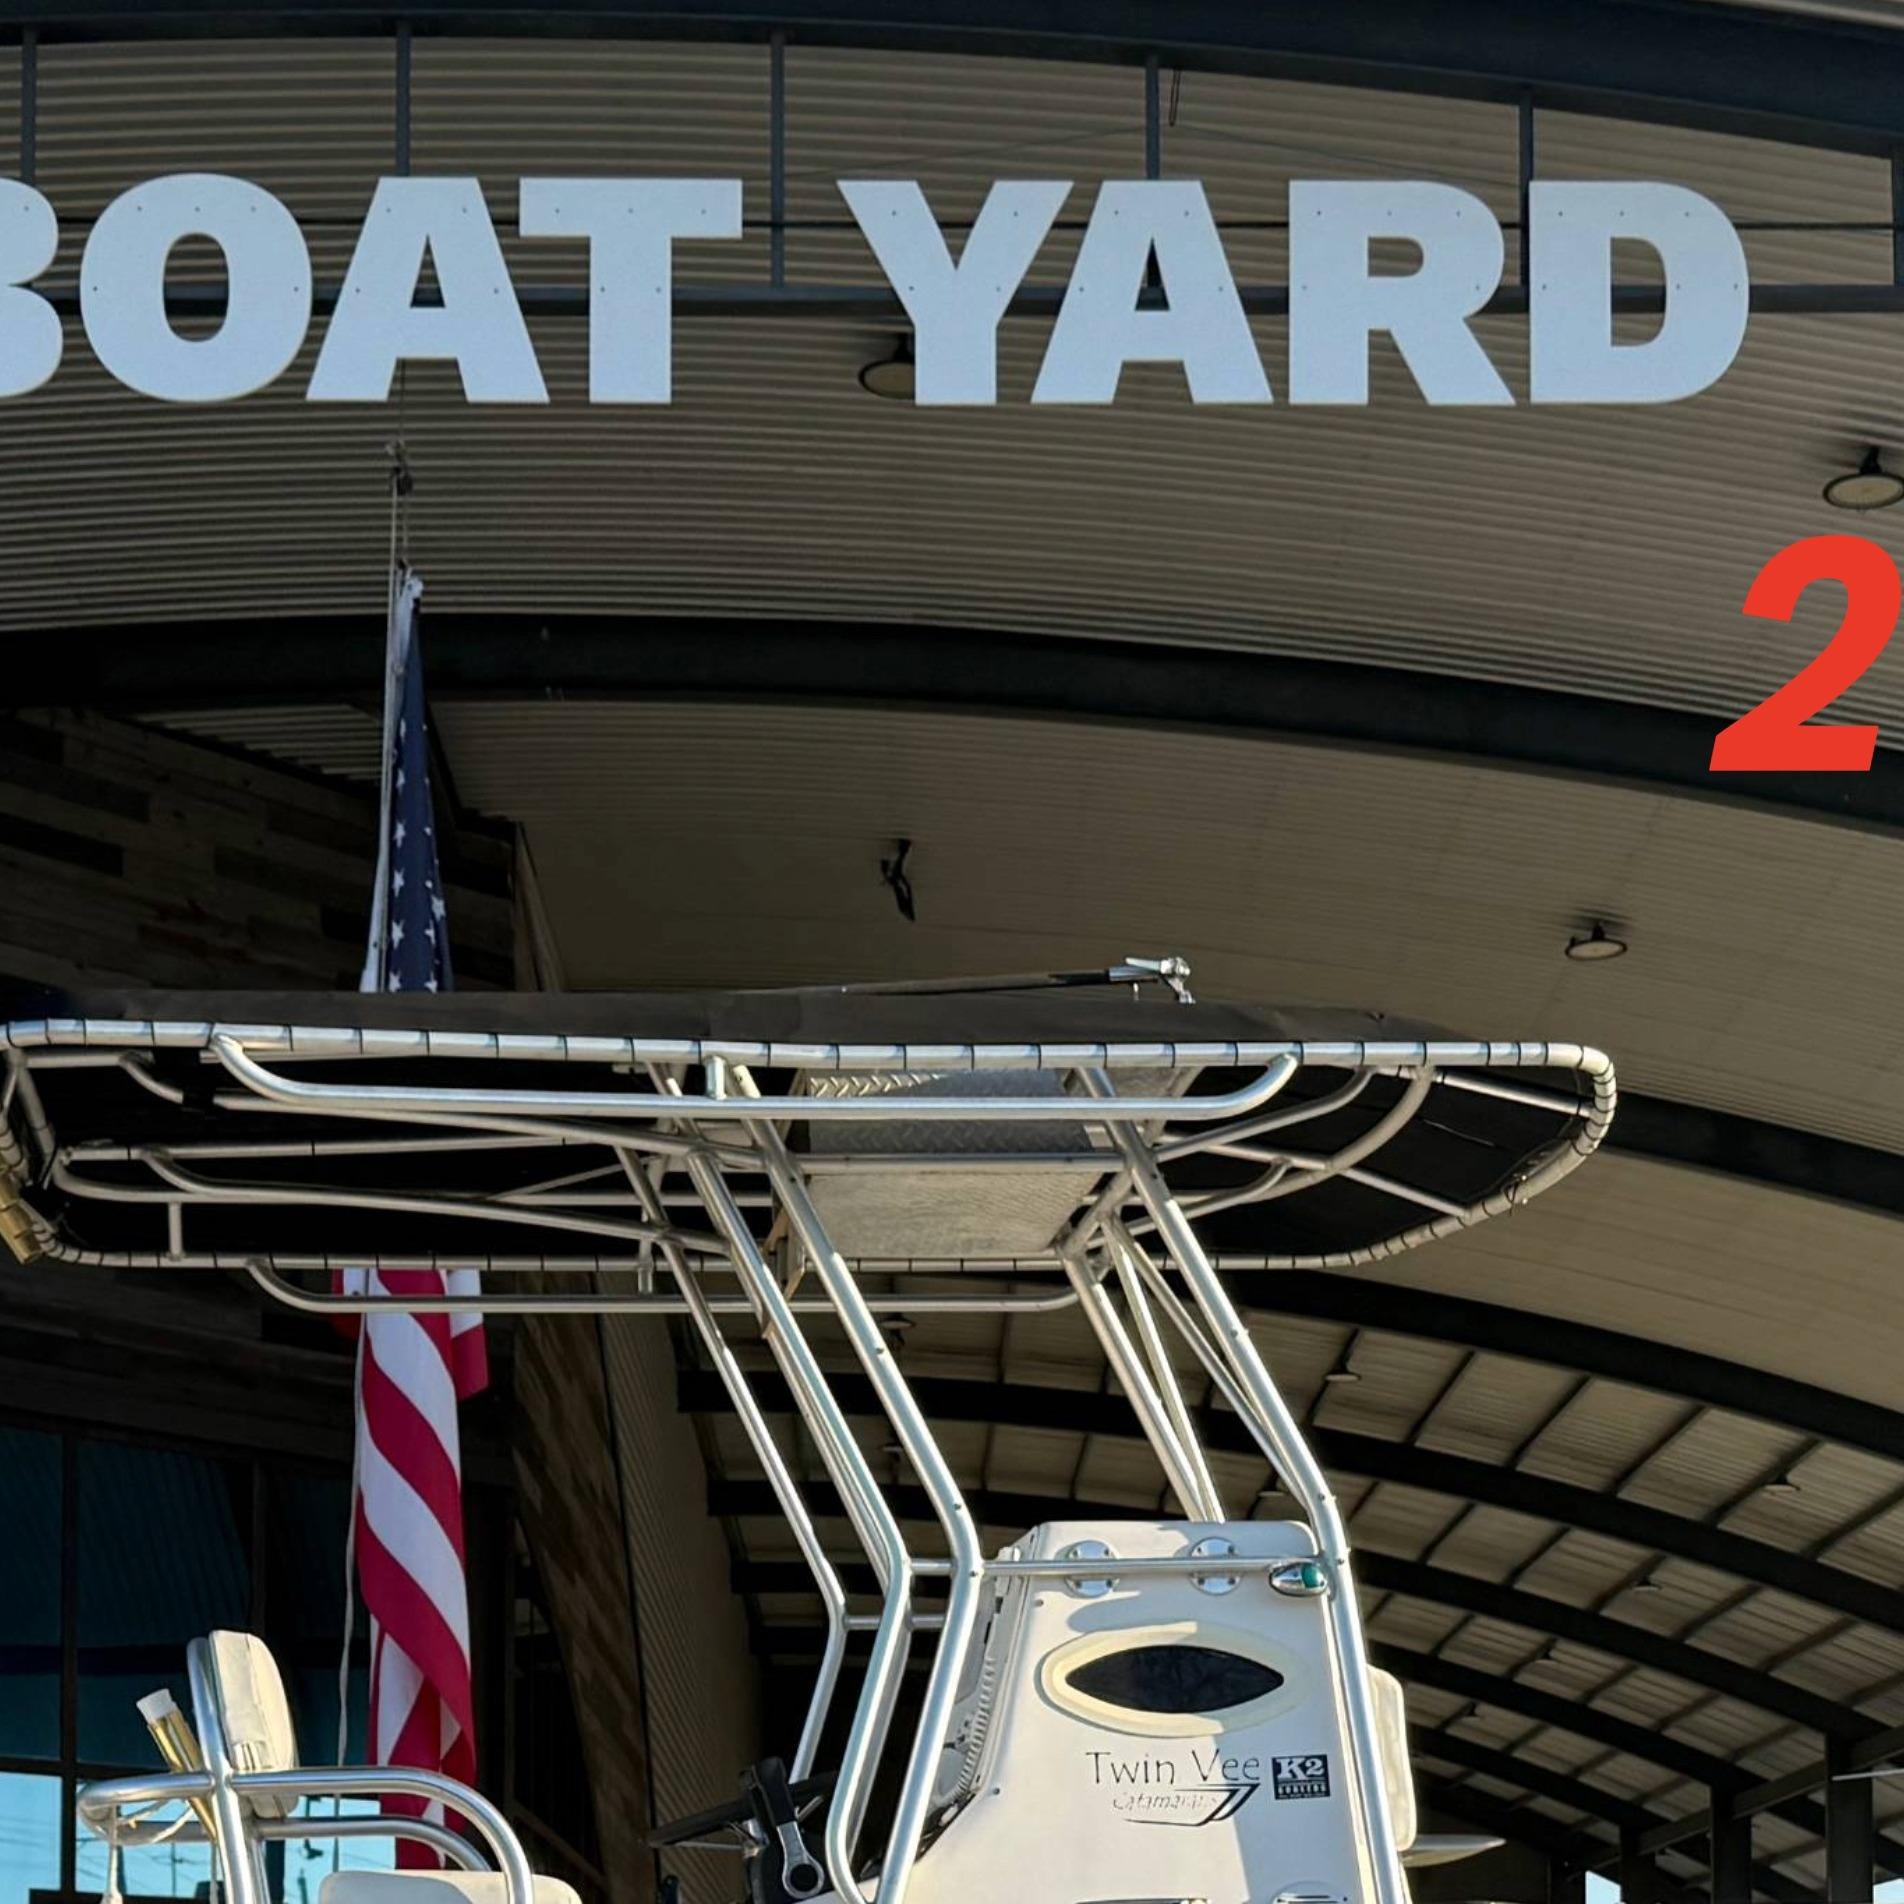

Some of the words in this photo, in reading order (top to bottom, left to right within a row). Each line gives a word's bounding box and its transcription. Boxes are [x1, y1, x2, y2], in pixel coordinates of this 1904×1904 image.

[838, 181, 1748, 405] YARD
[1085, 1750, 1176, 1785] Twin
[1191, 1748, 1261, 1782] Vee
[1276, 1757, 1325, 1780] K2
